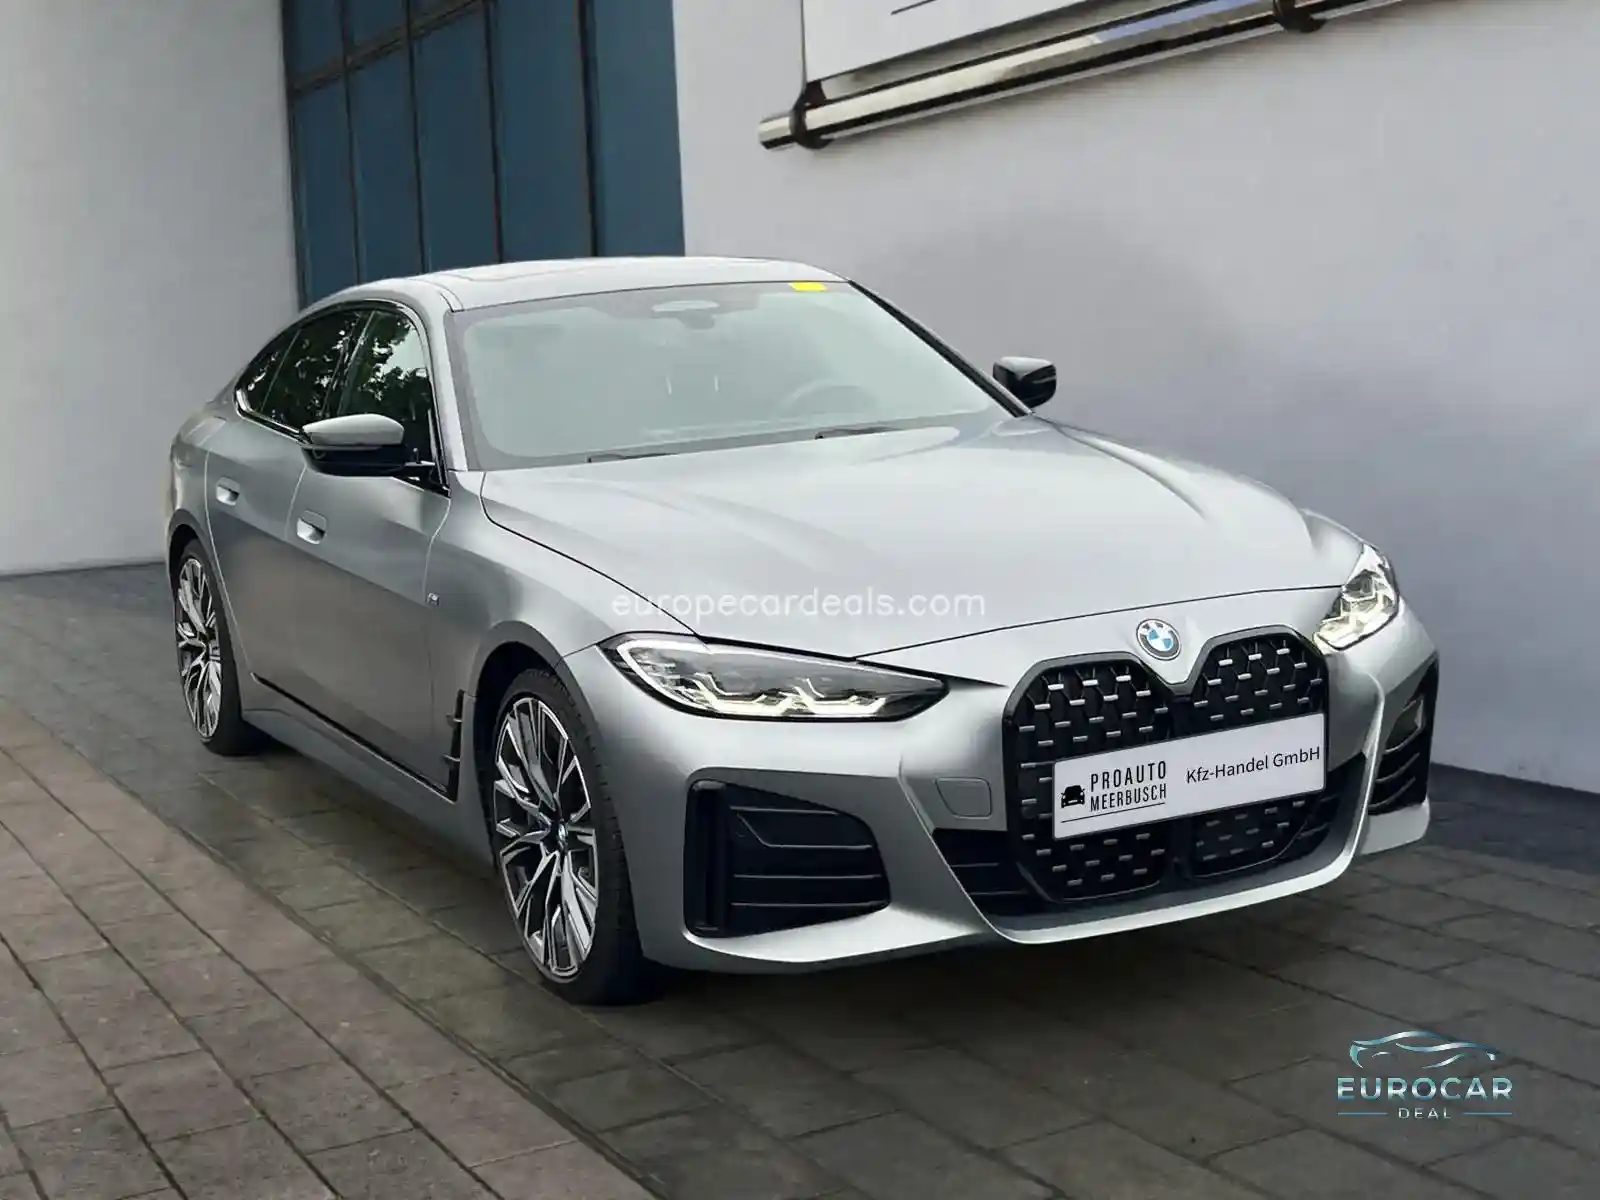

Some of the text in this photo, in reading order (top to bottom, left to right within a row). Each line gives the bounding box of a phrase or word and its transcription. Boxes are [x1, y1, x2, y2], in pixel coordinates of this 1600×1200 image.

[1091, 761, 1167, 792] PROAUTO
[1186, 747, 1320, 784] Kfz-Handel GmbH
[1090, 784, 1167, 812] MEERBUSCH
